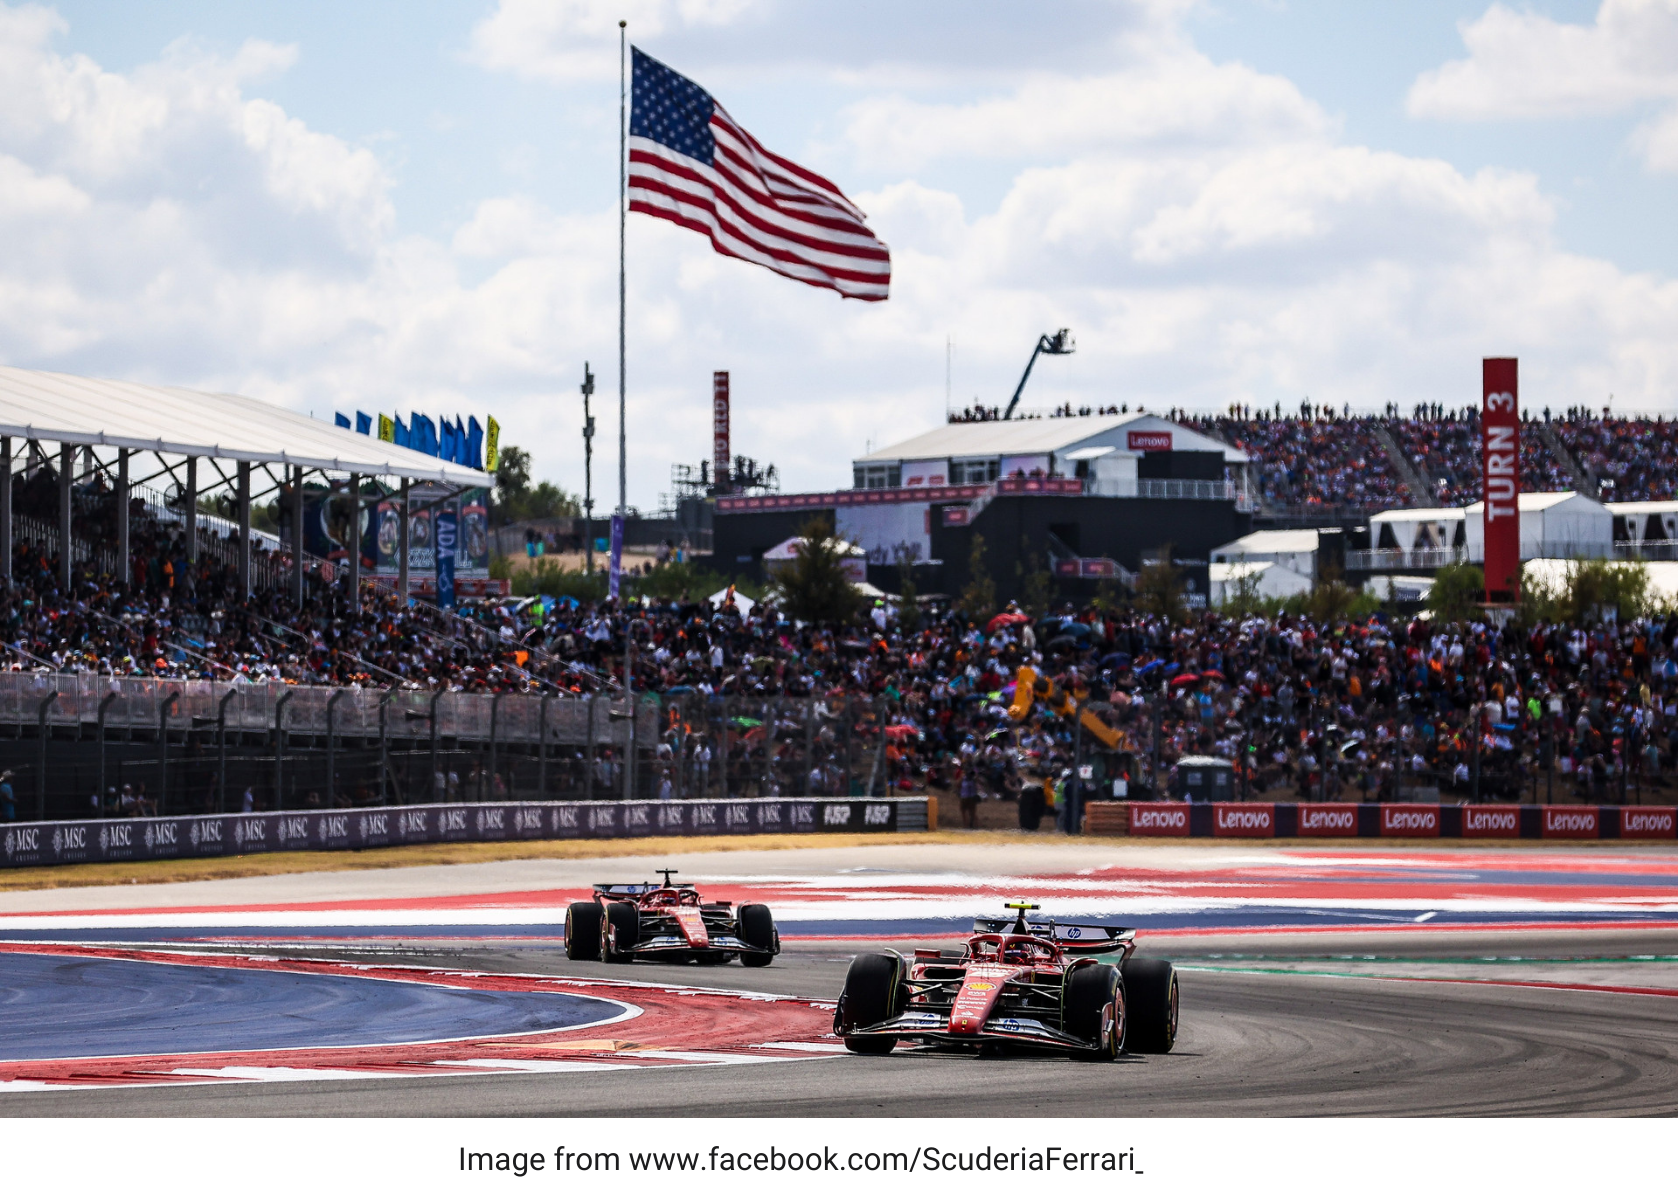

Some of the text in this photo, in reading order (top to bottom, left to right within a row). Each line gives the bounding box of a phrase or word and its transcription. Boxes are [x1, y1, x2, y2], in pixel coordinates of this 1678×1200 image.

[1131, 434, 1170, 447] Lenovo
[1487, 391, 1516, 523] TURN 3
[436, 519, 456, 560] ADA
[287, 817, 308, 838] MSC
[328, 815, 348, 837] MSC
[368, 813, 388, 835] MSC
[408, 811, 427, 832] MSC
[447, 810, 467, 830] MSC
[485, 809, 504, 829] MSC
[1132, 808, 1186, 828] Lenovo
[1218, 808, 1270, 828] Lenovo
[1302, 809, 1354, 829] Lenovo
[1385, 809, 1436, 829] Lenovo
[1467, 810, 1516, 830] Lenovo
[1547, 811, 1596, 831] Lenovo
[1625, 811, 1673, 831] Lenovo
[16, 828, 39, 851] MSC
[64, 827, 86, 849] MSC
[110, 825, 132, 846] MSC
[155, 822, 178, 845] MSC
[201, 820, 222, 842] MSC
[245, 819, 266, 840] MSC
[1068, 927, 1081, 939] hp
